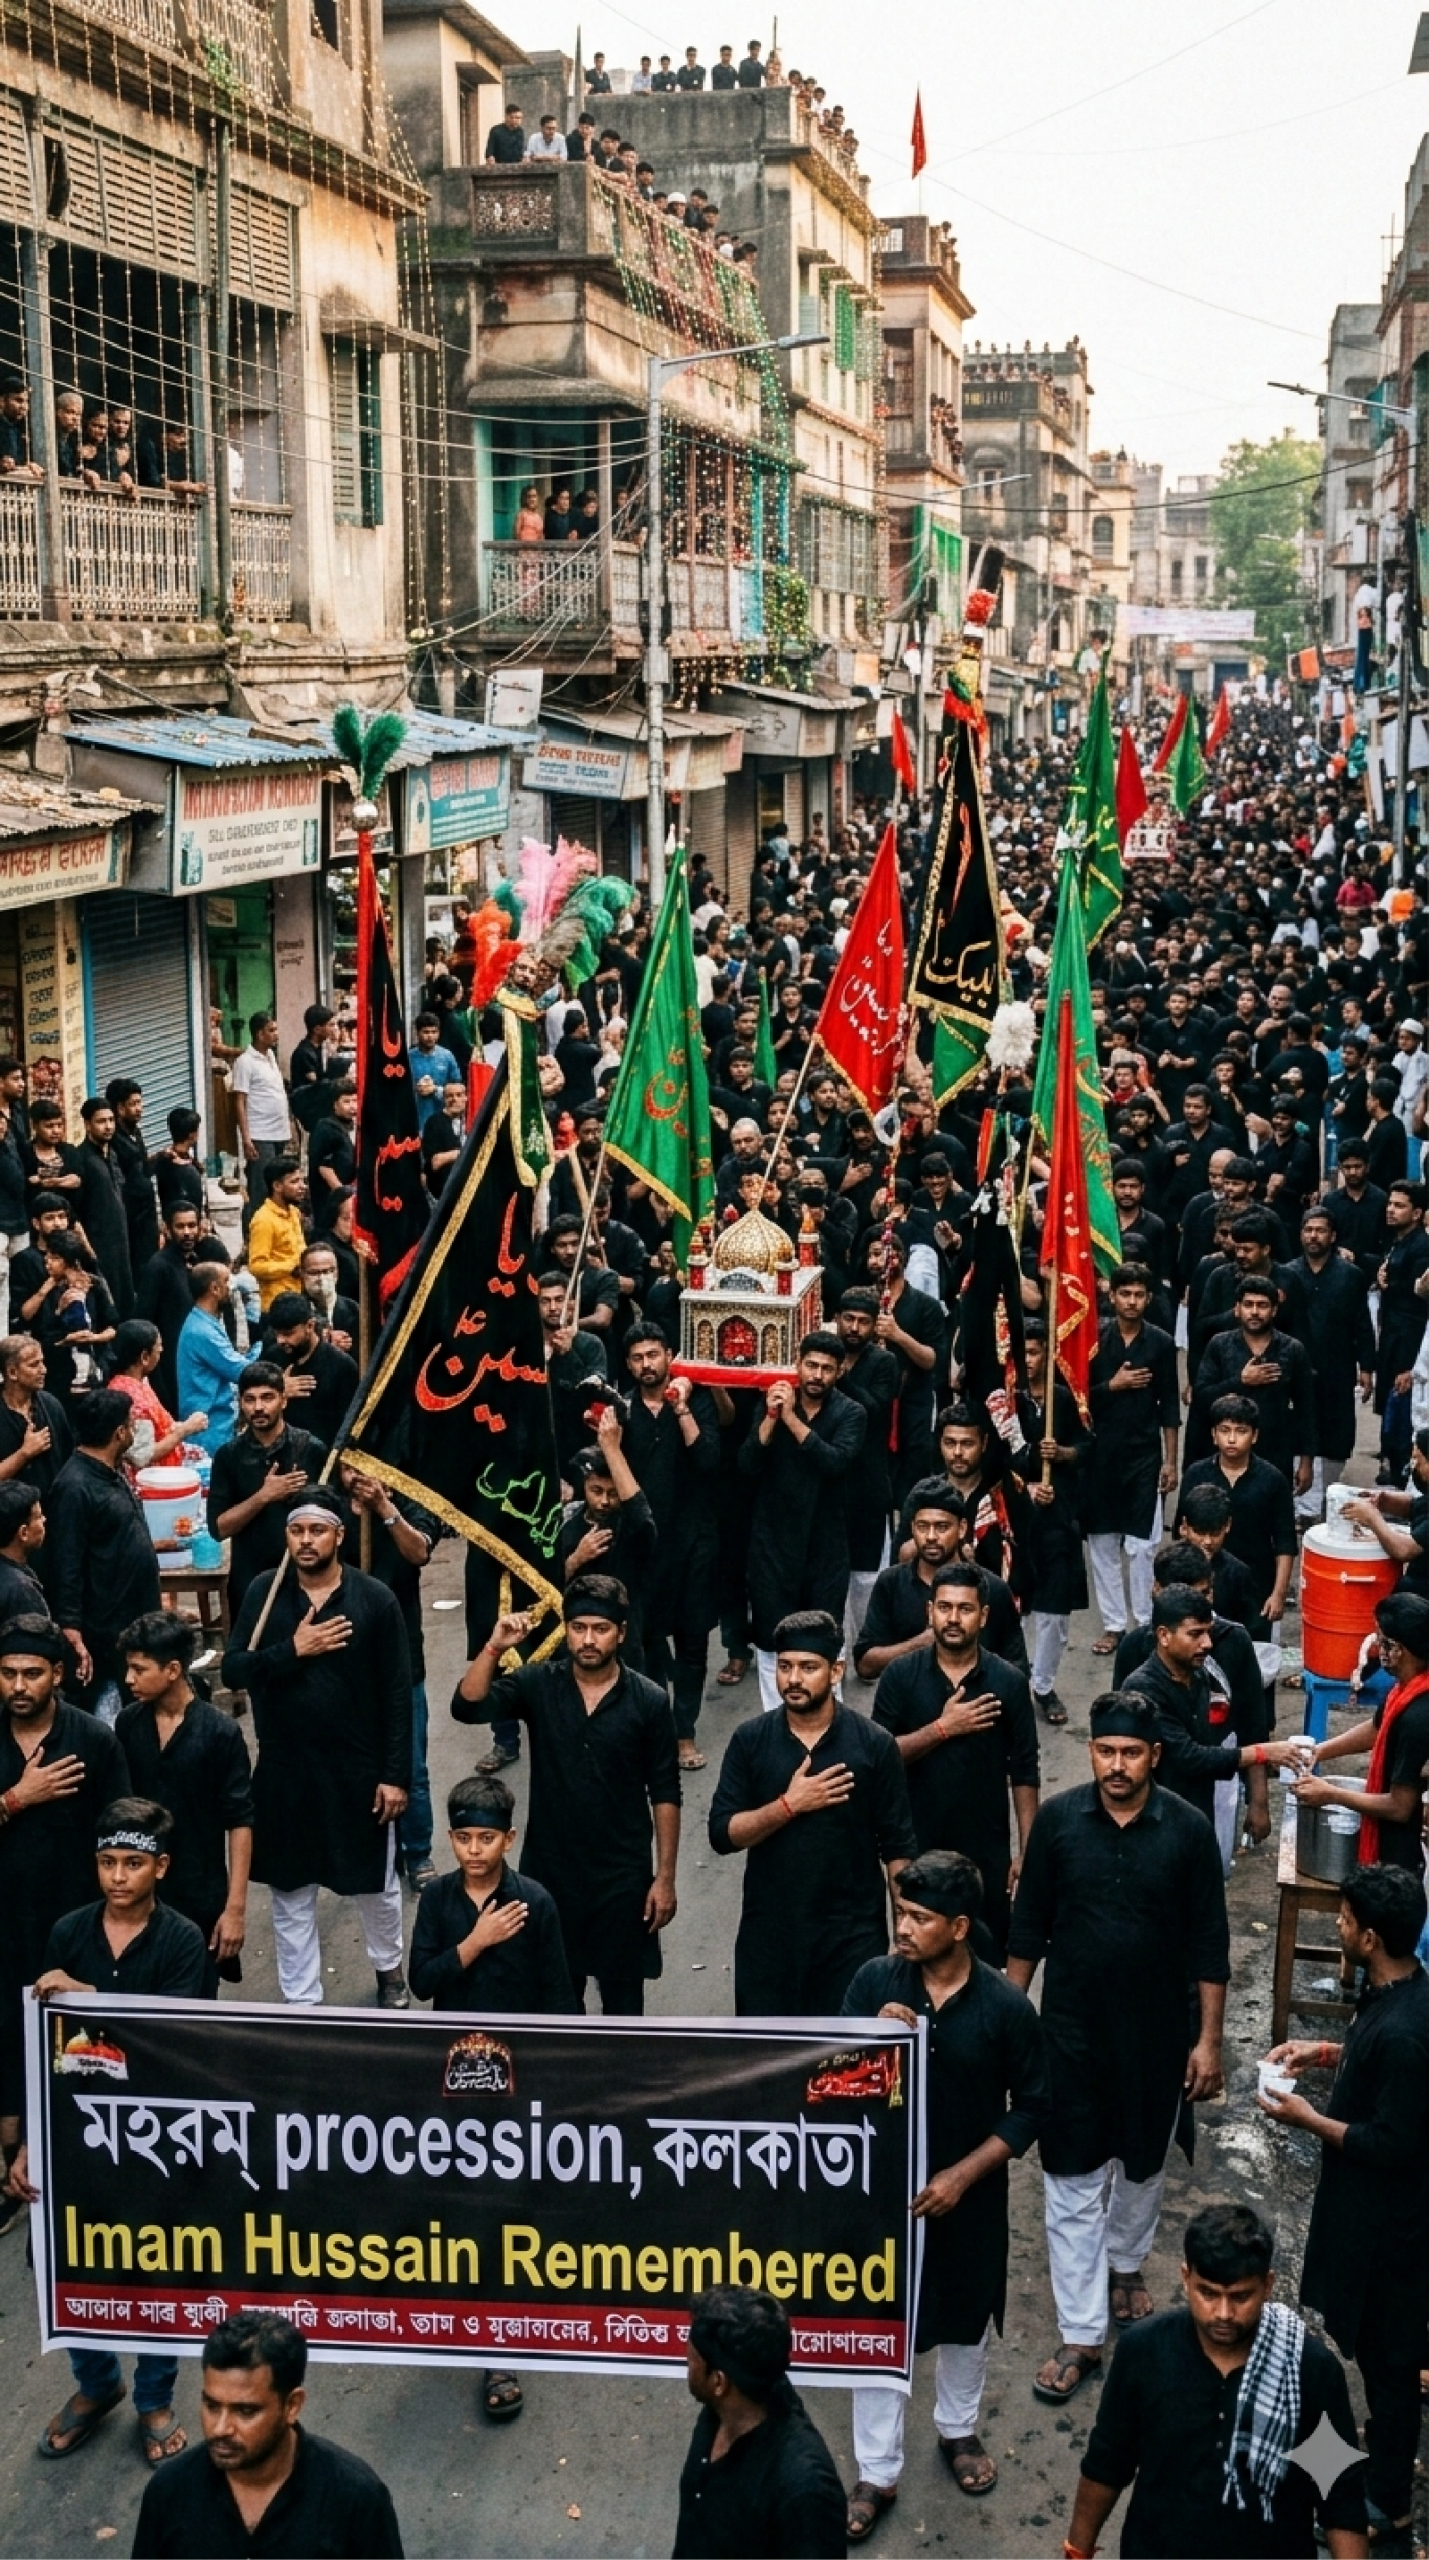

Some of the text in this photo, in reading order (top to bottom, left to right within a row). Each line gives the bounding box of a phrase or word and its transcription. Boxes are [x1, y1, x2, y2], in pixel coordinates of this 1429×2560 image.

[487, 1191, 525, 1298] يا
[72, 2094, 878, 2200] মহরম্ procession, কলকাতা
[65, 2205, 896, 2302] Imam Hussain Remembered
